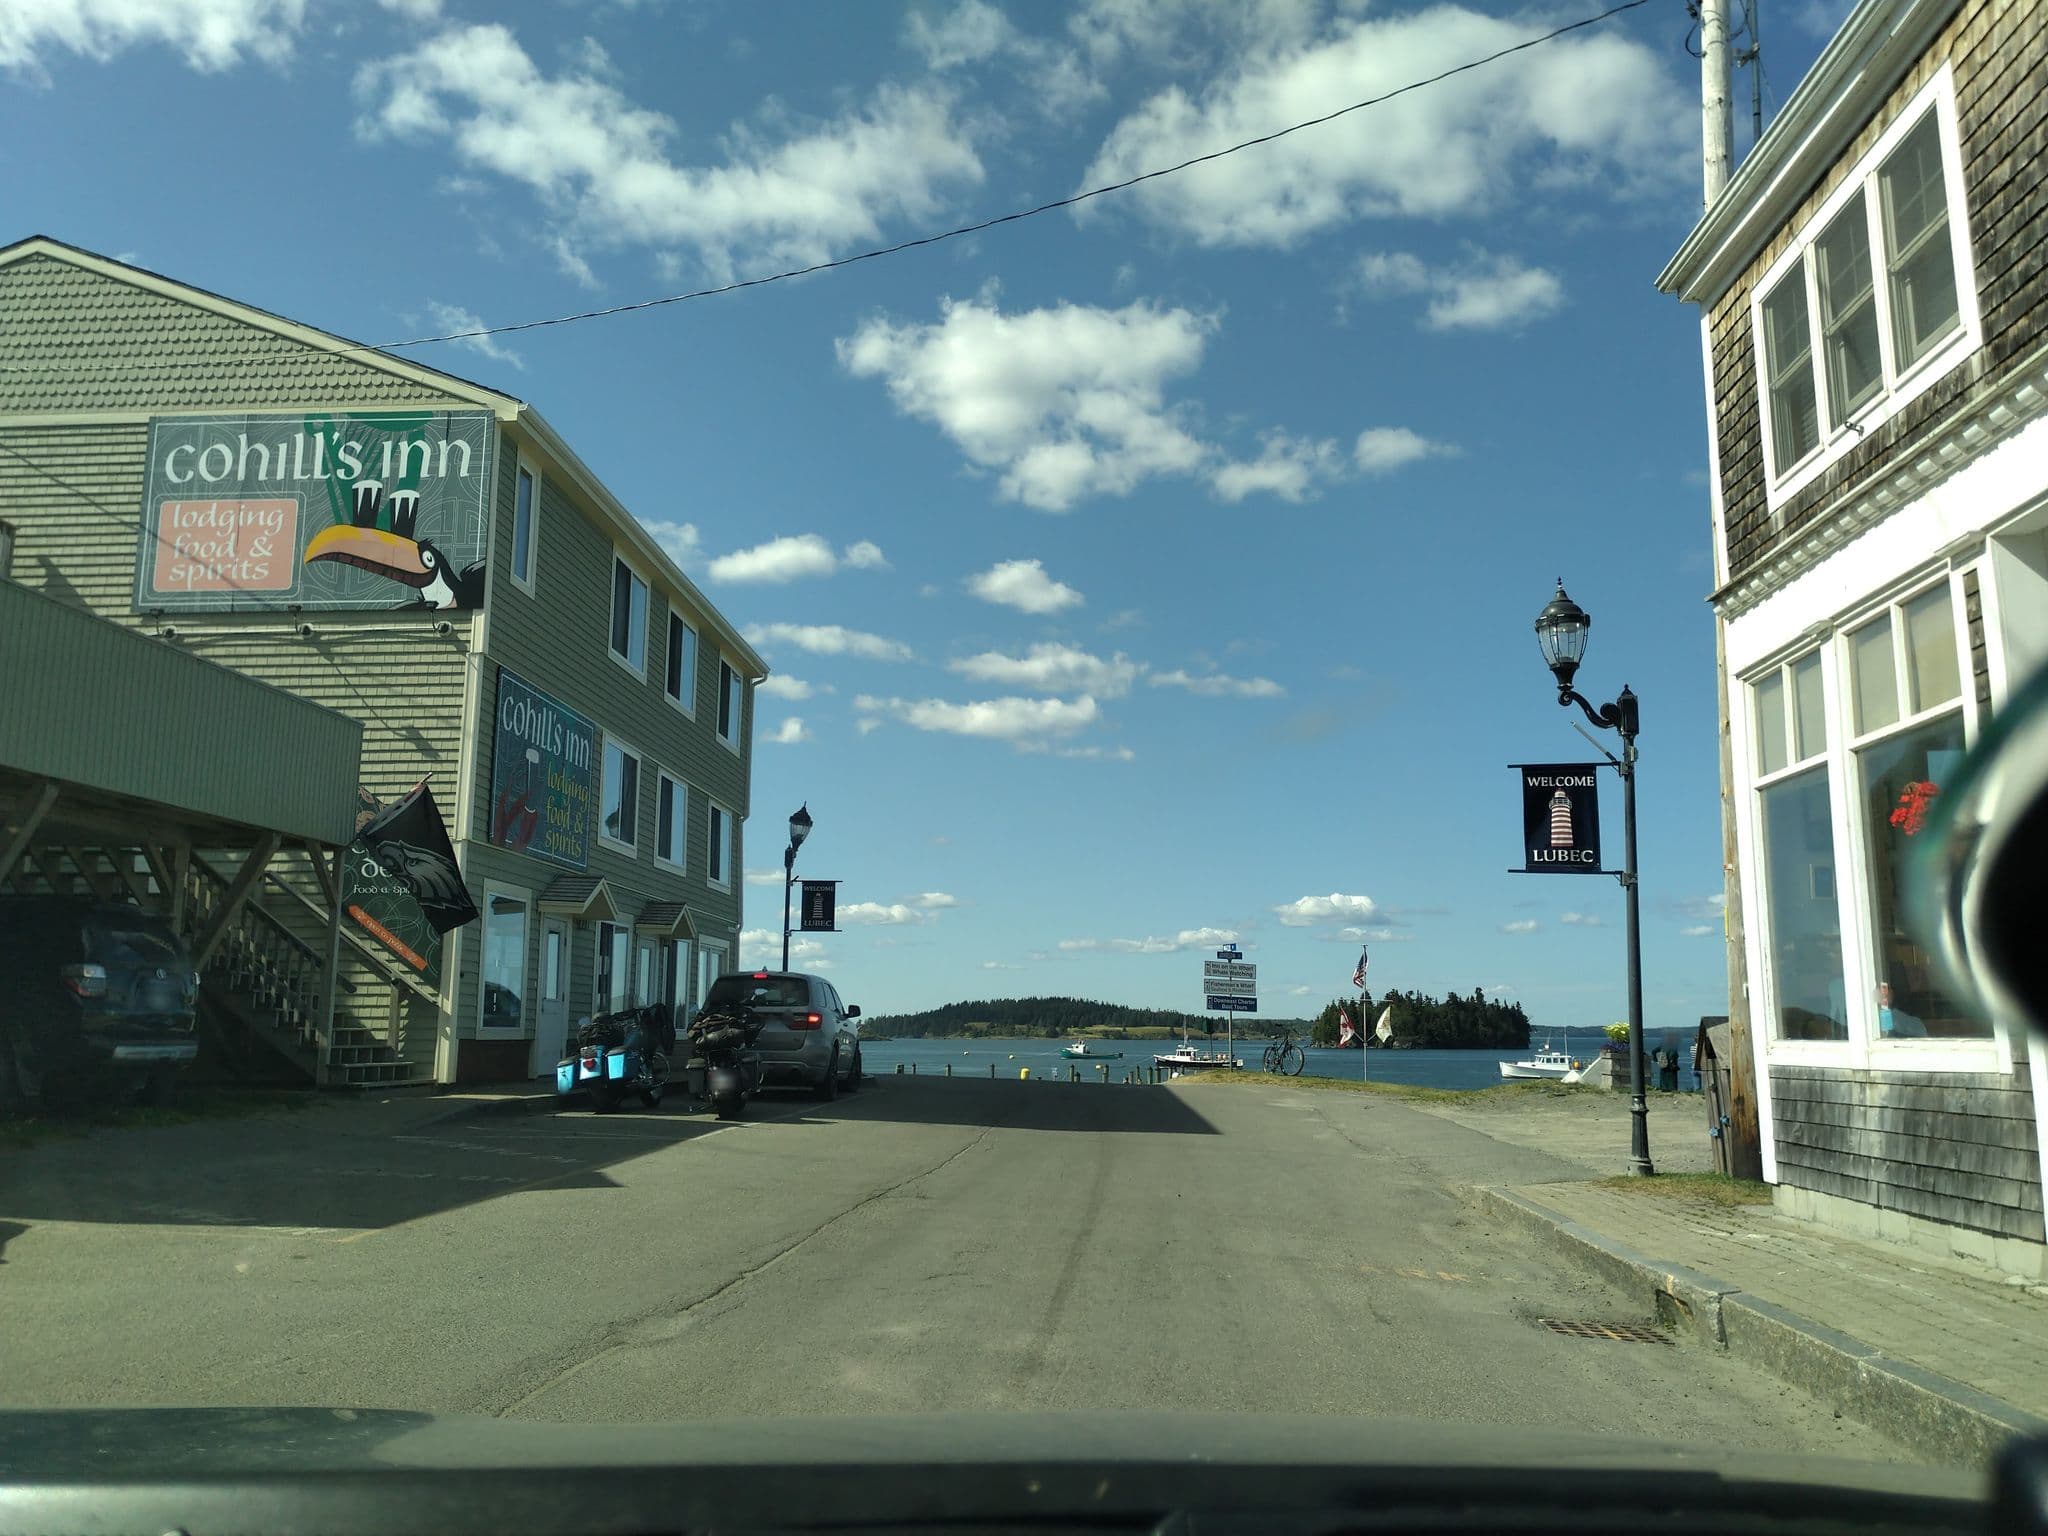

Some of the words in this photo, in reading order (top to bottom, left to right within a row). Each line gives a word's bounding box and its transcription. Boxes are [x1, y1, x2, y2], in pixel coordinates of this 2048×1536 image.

[382, 437, 473, 478] inn
[172, 503, 284, 537] lodging
[173, 532, 236, 561] food
[249, 536, 273, 558] &
[168, 558, 270, 590] spirits
[565, 729, 590, 771] inn
[547, 761, 589, 812] lodging
[1527, 776, 1595, 787] WELCOME
[546, 795, 570, 830] food
[574, 812, 584, 834] &
[545, 829, 582, 860] spirits
[1533, 849, 1594, 862] LUBEC
[1229, 970, 1253, 978] Watching
